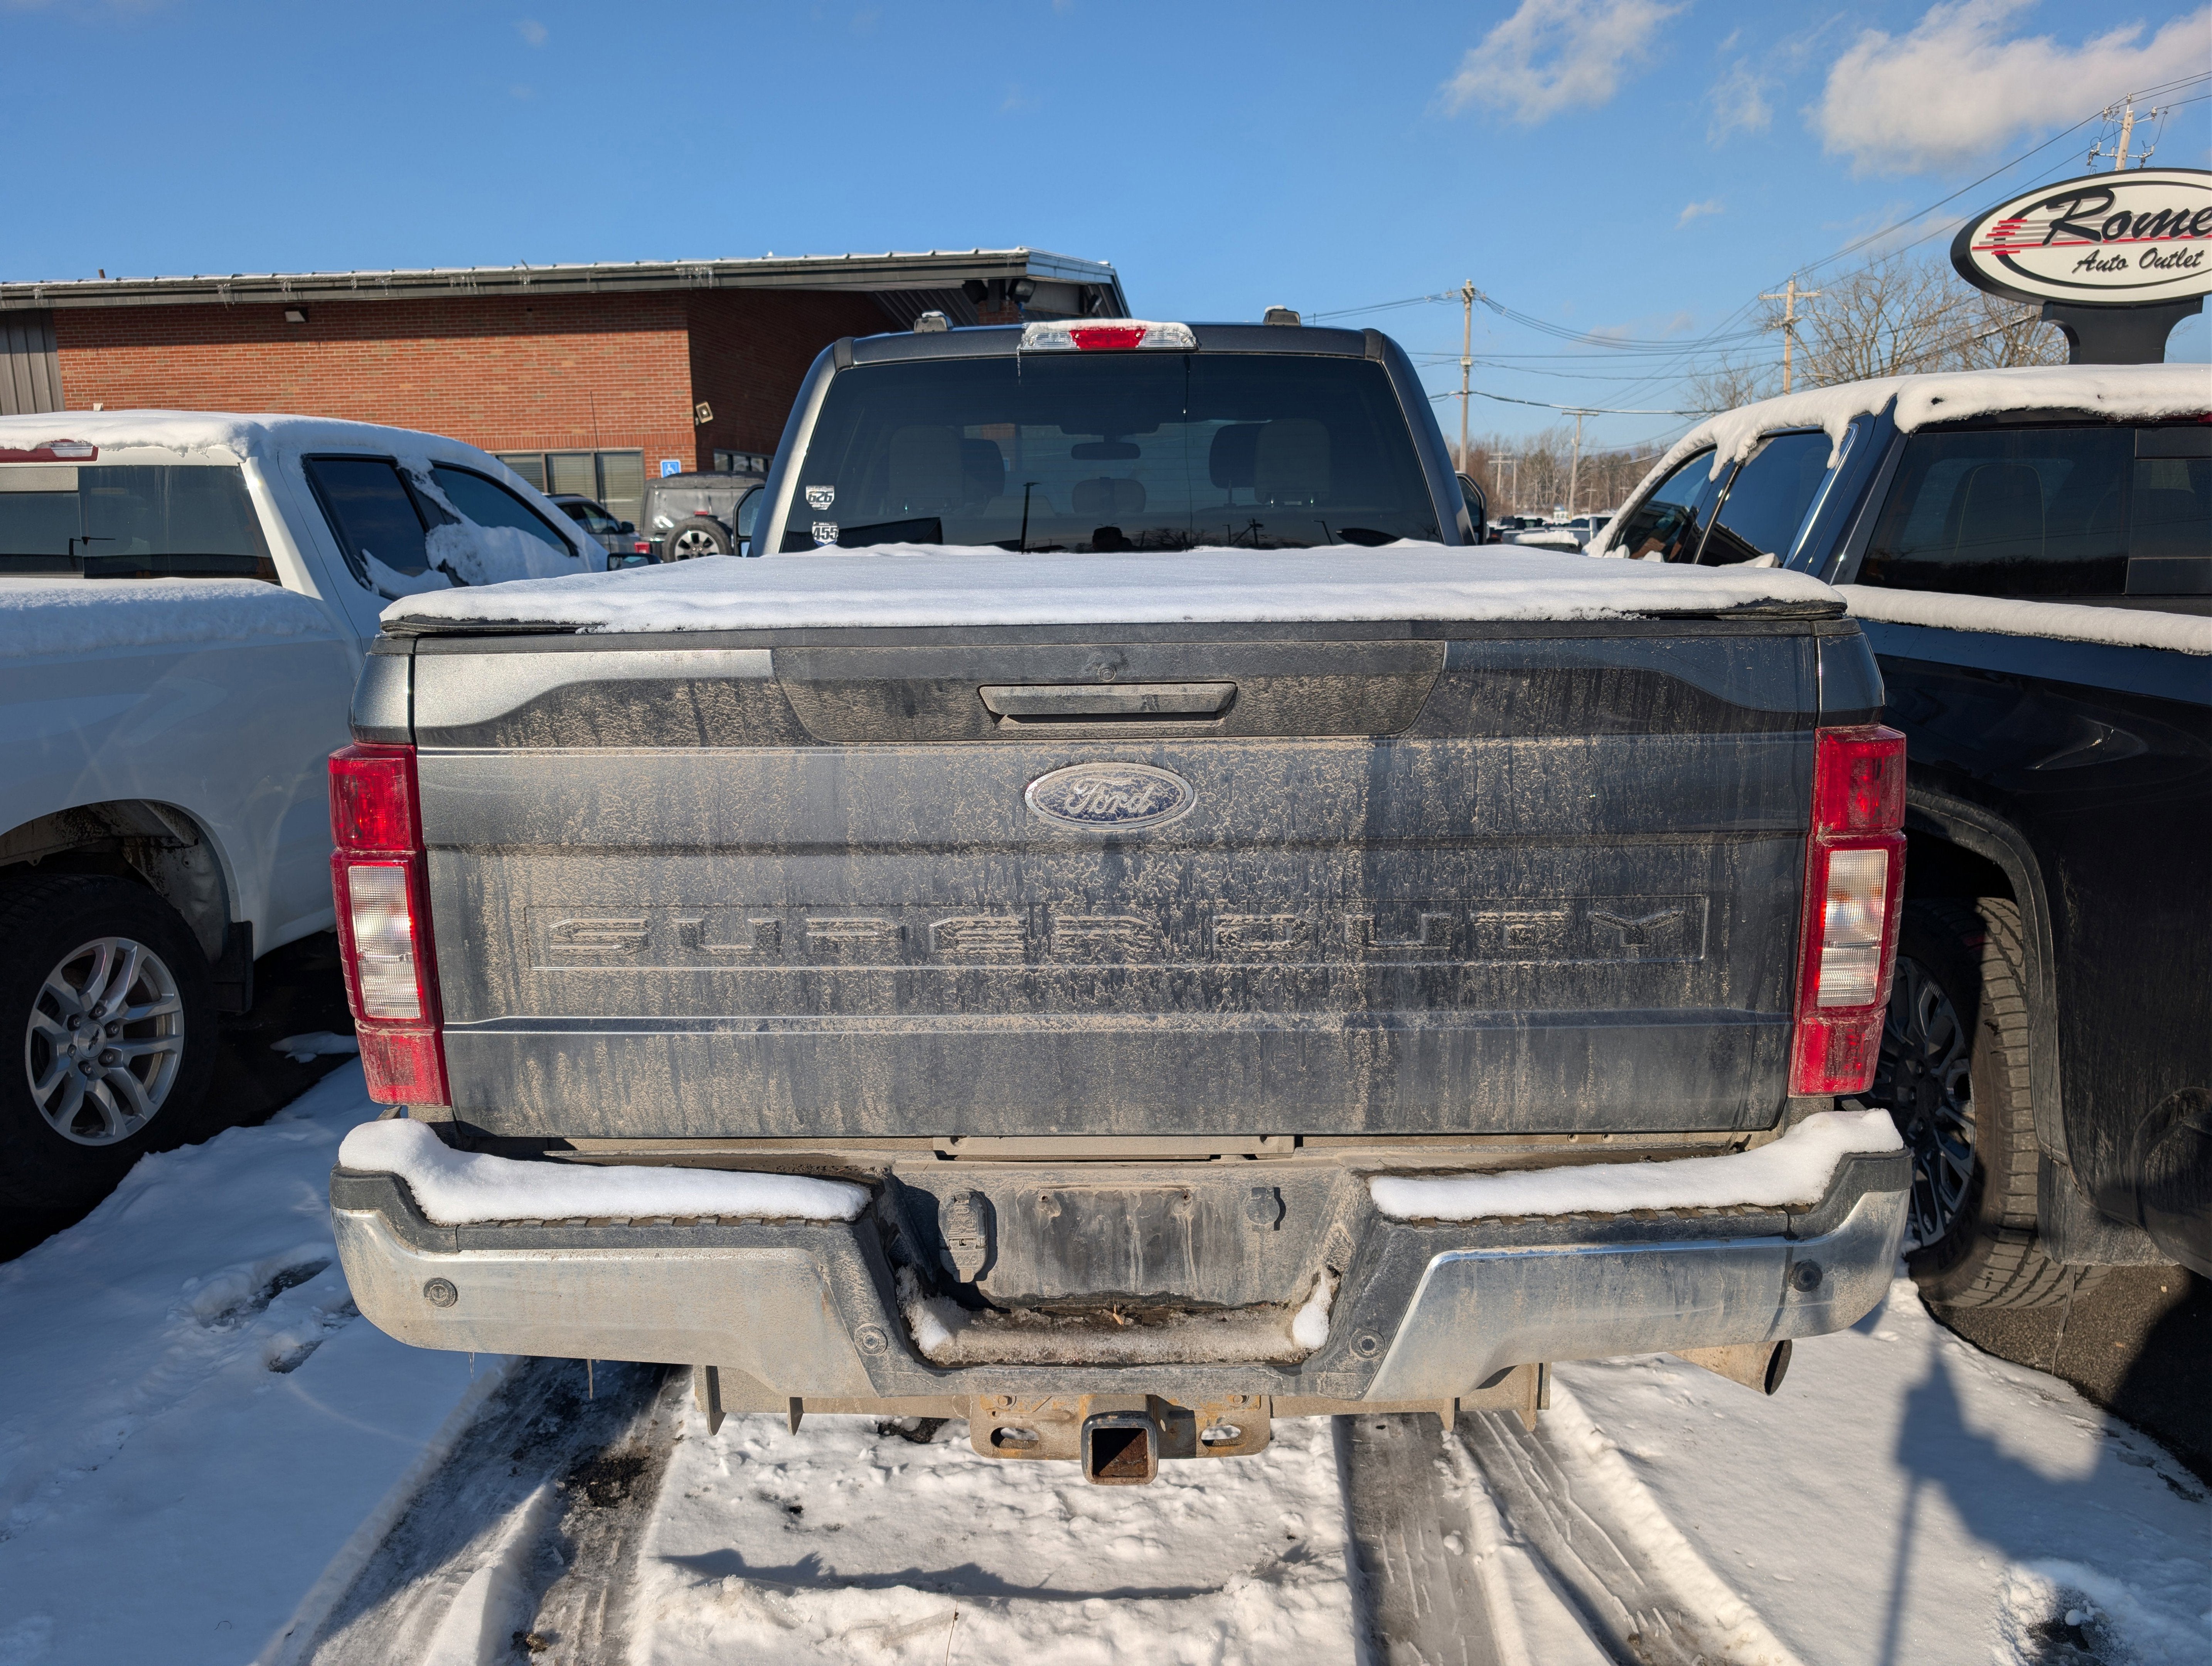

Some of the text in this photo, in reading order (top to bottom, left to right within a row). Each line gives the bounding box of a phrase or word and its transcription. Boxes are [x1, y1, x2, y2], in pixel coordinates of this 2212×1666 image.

[2071, 247, 2205, 274] Auto Outlet
[808, 491, 834, 503] 626
[813, 527, 838, 540] 455
[1065, 777, 1154, 814] Ford
[548, 909, 1685, 956] SUPER DUTY
